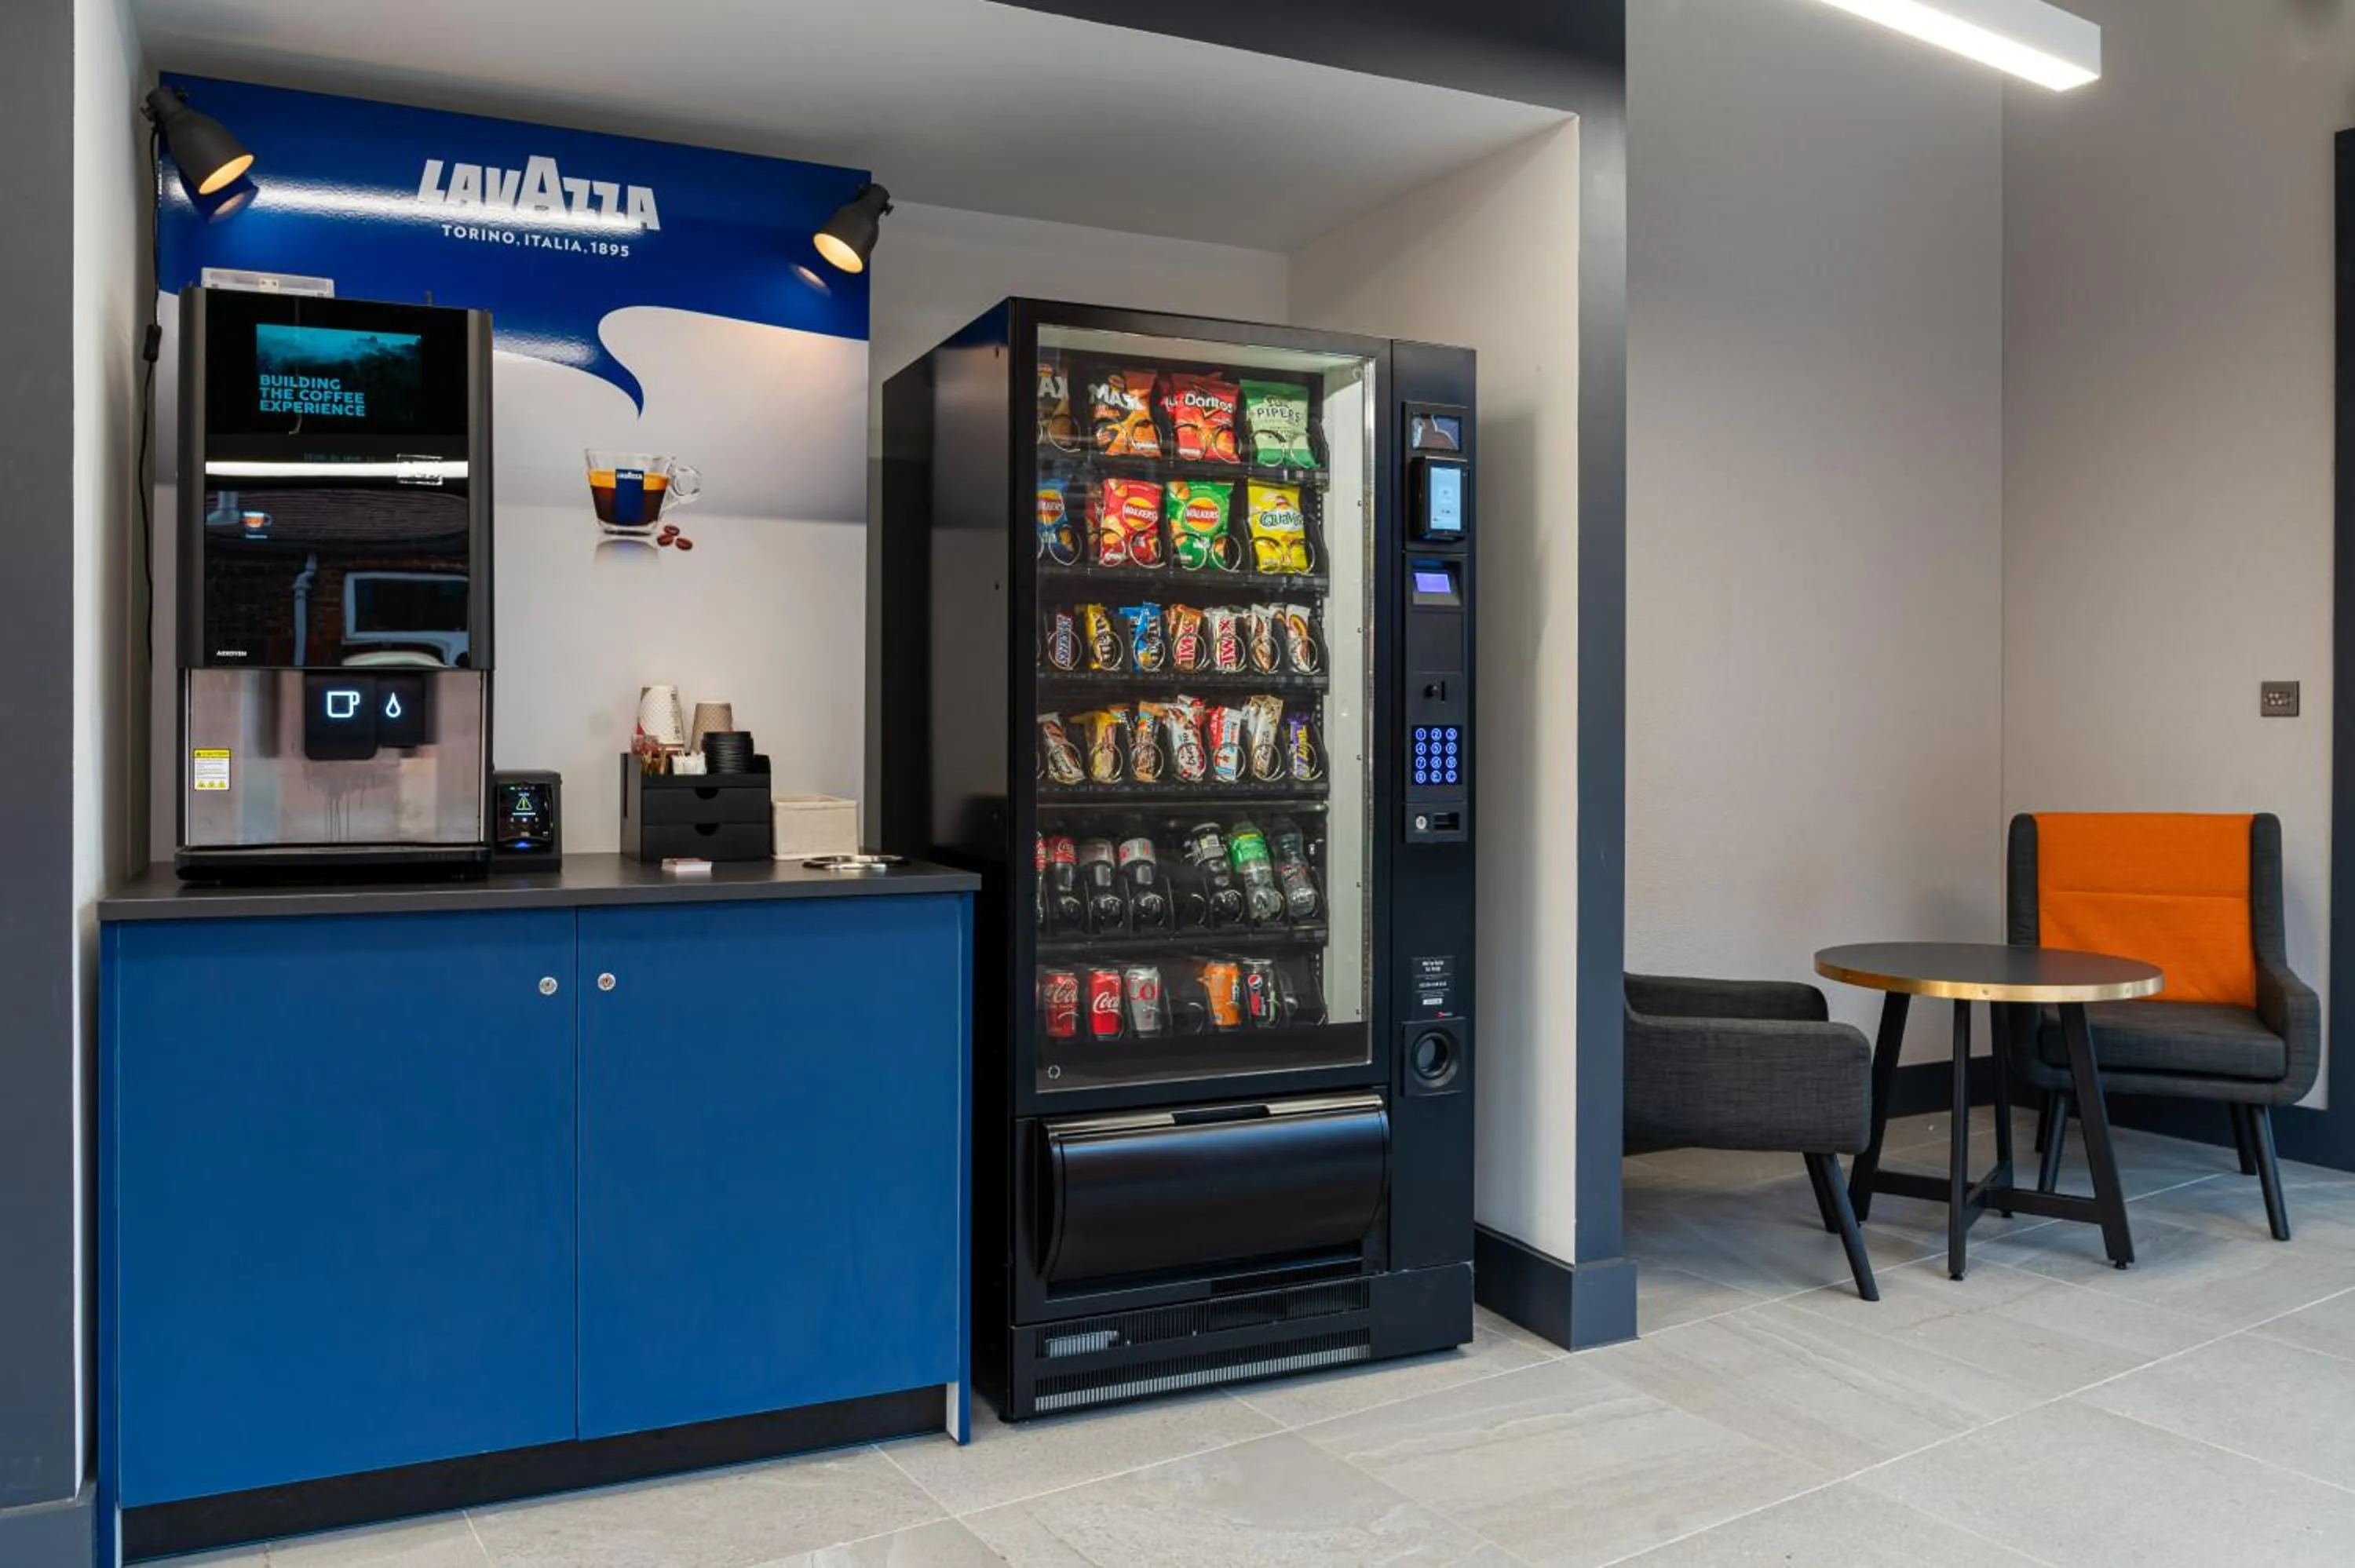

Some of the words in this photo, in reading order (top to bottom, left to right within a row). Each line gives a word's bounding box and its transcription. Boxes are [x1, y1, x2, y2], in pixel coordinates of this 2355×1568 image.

[417, 155, 661, 232] LAVAZZA
[590, 241, 630, 257] 1895
[260, 374, 341, 391] BUILDING
[259, 387, 294, 400] THE
[299, 390, 366, 404] COFFEE
[1088, 381, 1147, 410] MAX
[1185, 393, 1233, 414] Doritos
[260, 399, 366, 417] EXPERIENCE
[1178, 622, 1196, 665] TWX
[1218, 617, 1237, 665] TWX
